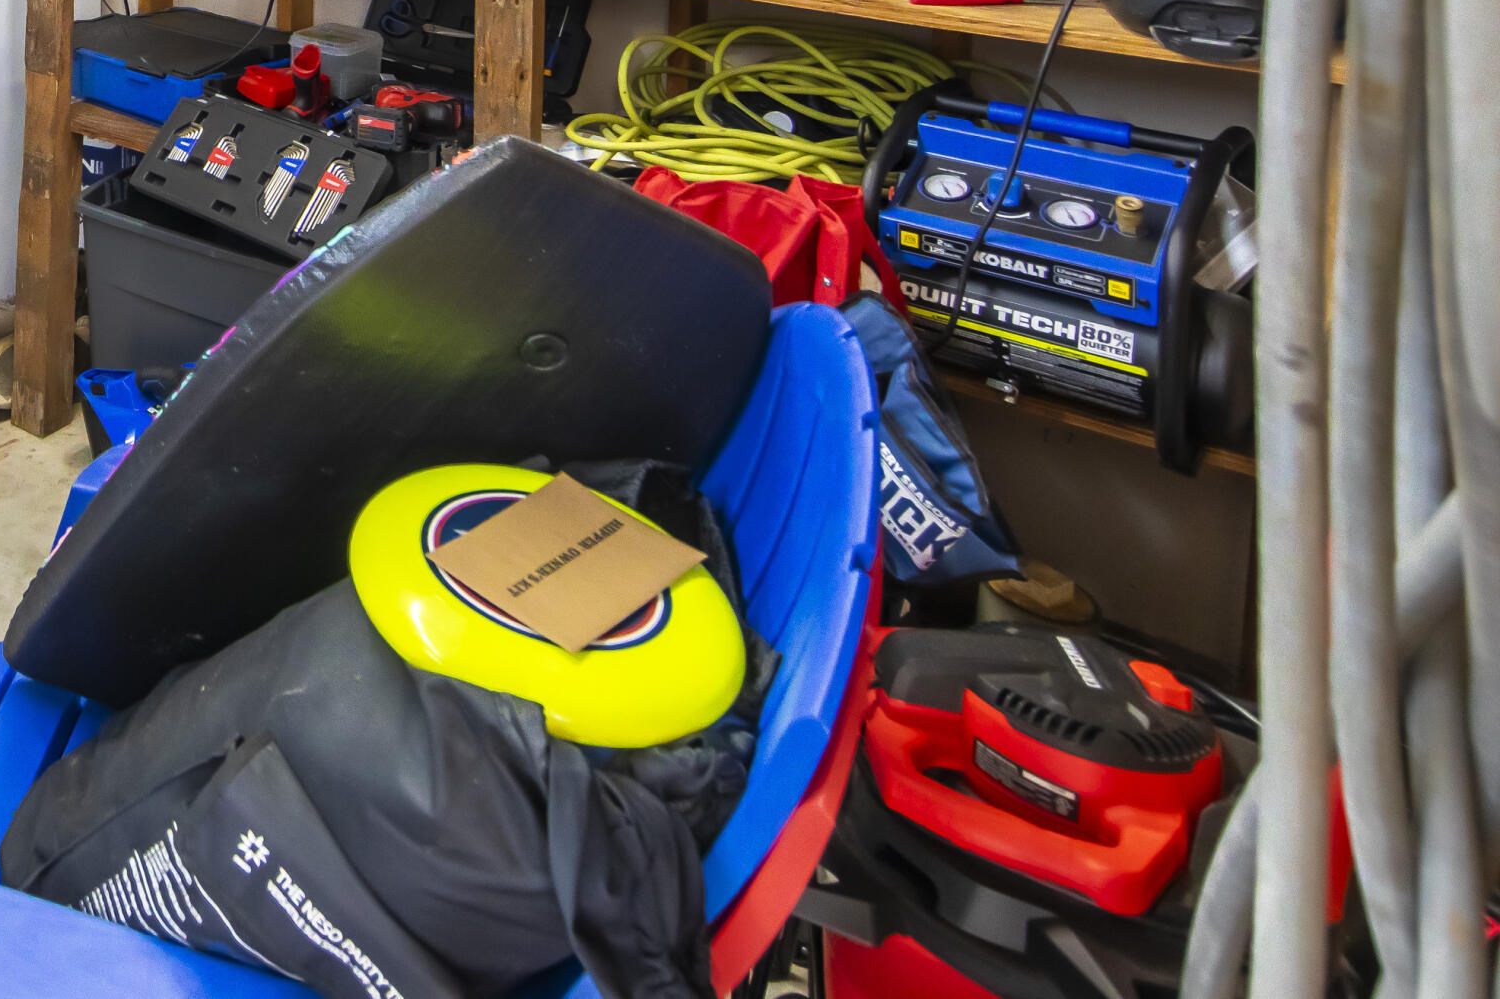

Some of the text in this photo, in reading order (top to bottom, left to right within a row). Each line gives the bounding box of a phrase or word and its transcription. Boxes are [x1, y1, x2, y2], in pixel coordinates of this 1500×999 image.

[973, 251, 1049, 279] KOBALT
[993, 304, 1077, 341] TECH
[1080, 323, 1131, 350] 80%
[1080, 338, 1131, 359] QUIETER
[506, 576, 530, 599] KIT
[276, 866, 390, 987] THE NESO PARTY
